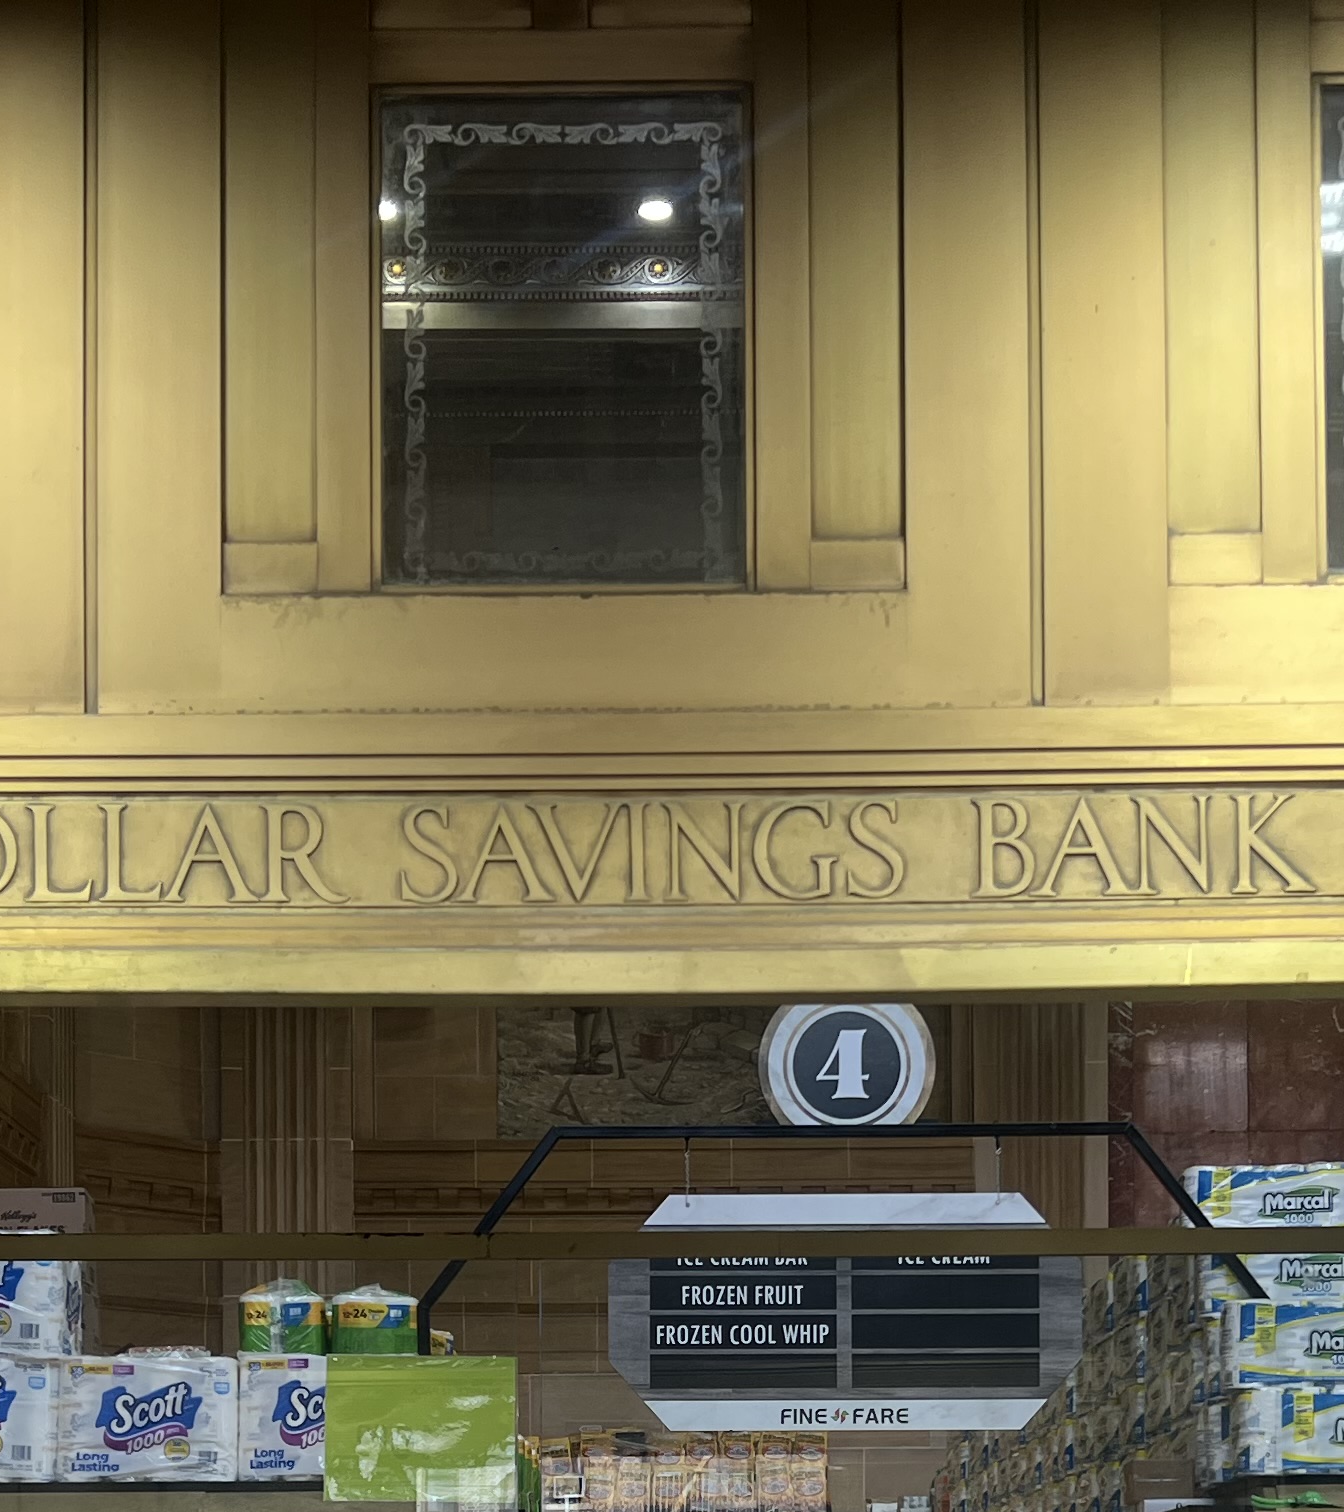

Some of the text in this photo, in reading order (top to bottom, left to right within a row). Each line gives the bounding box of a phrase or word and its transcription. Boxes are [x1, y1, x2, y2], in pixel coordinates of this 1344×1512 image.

[399, 799, 906, 904] SAVINGS
[969, 794, 1318, 900] BANK
[815, 1028, 870, 1100] 4
[1264, 1188, 1333, 1217] Marcal
[1283, 1212, 1313, 1224] 1000
[681, 1284, 804, 1307] FROZEN FRUIT
[656, 1323, 830, 1346] FROZEN COOL WHIP
[110, 1383, 188, 1434] Scott
[780, 1407, 910, 1425] FINE FARE
[125, 1429, 165, 1455] 1000
[76, 1452, 110, 1463] Long
[249, 1458, 295, 1470] Lasting
[254, 1448, 285, 1460] Long
